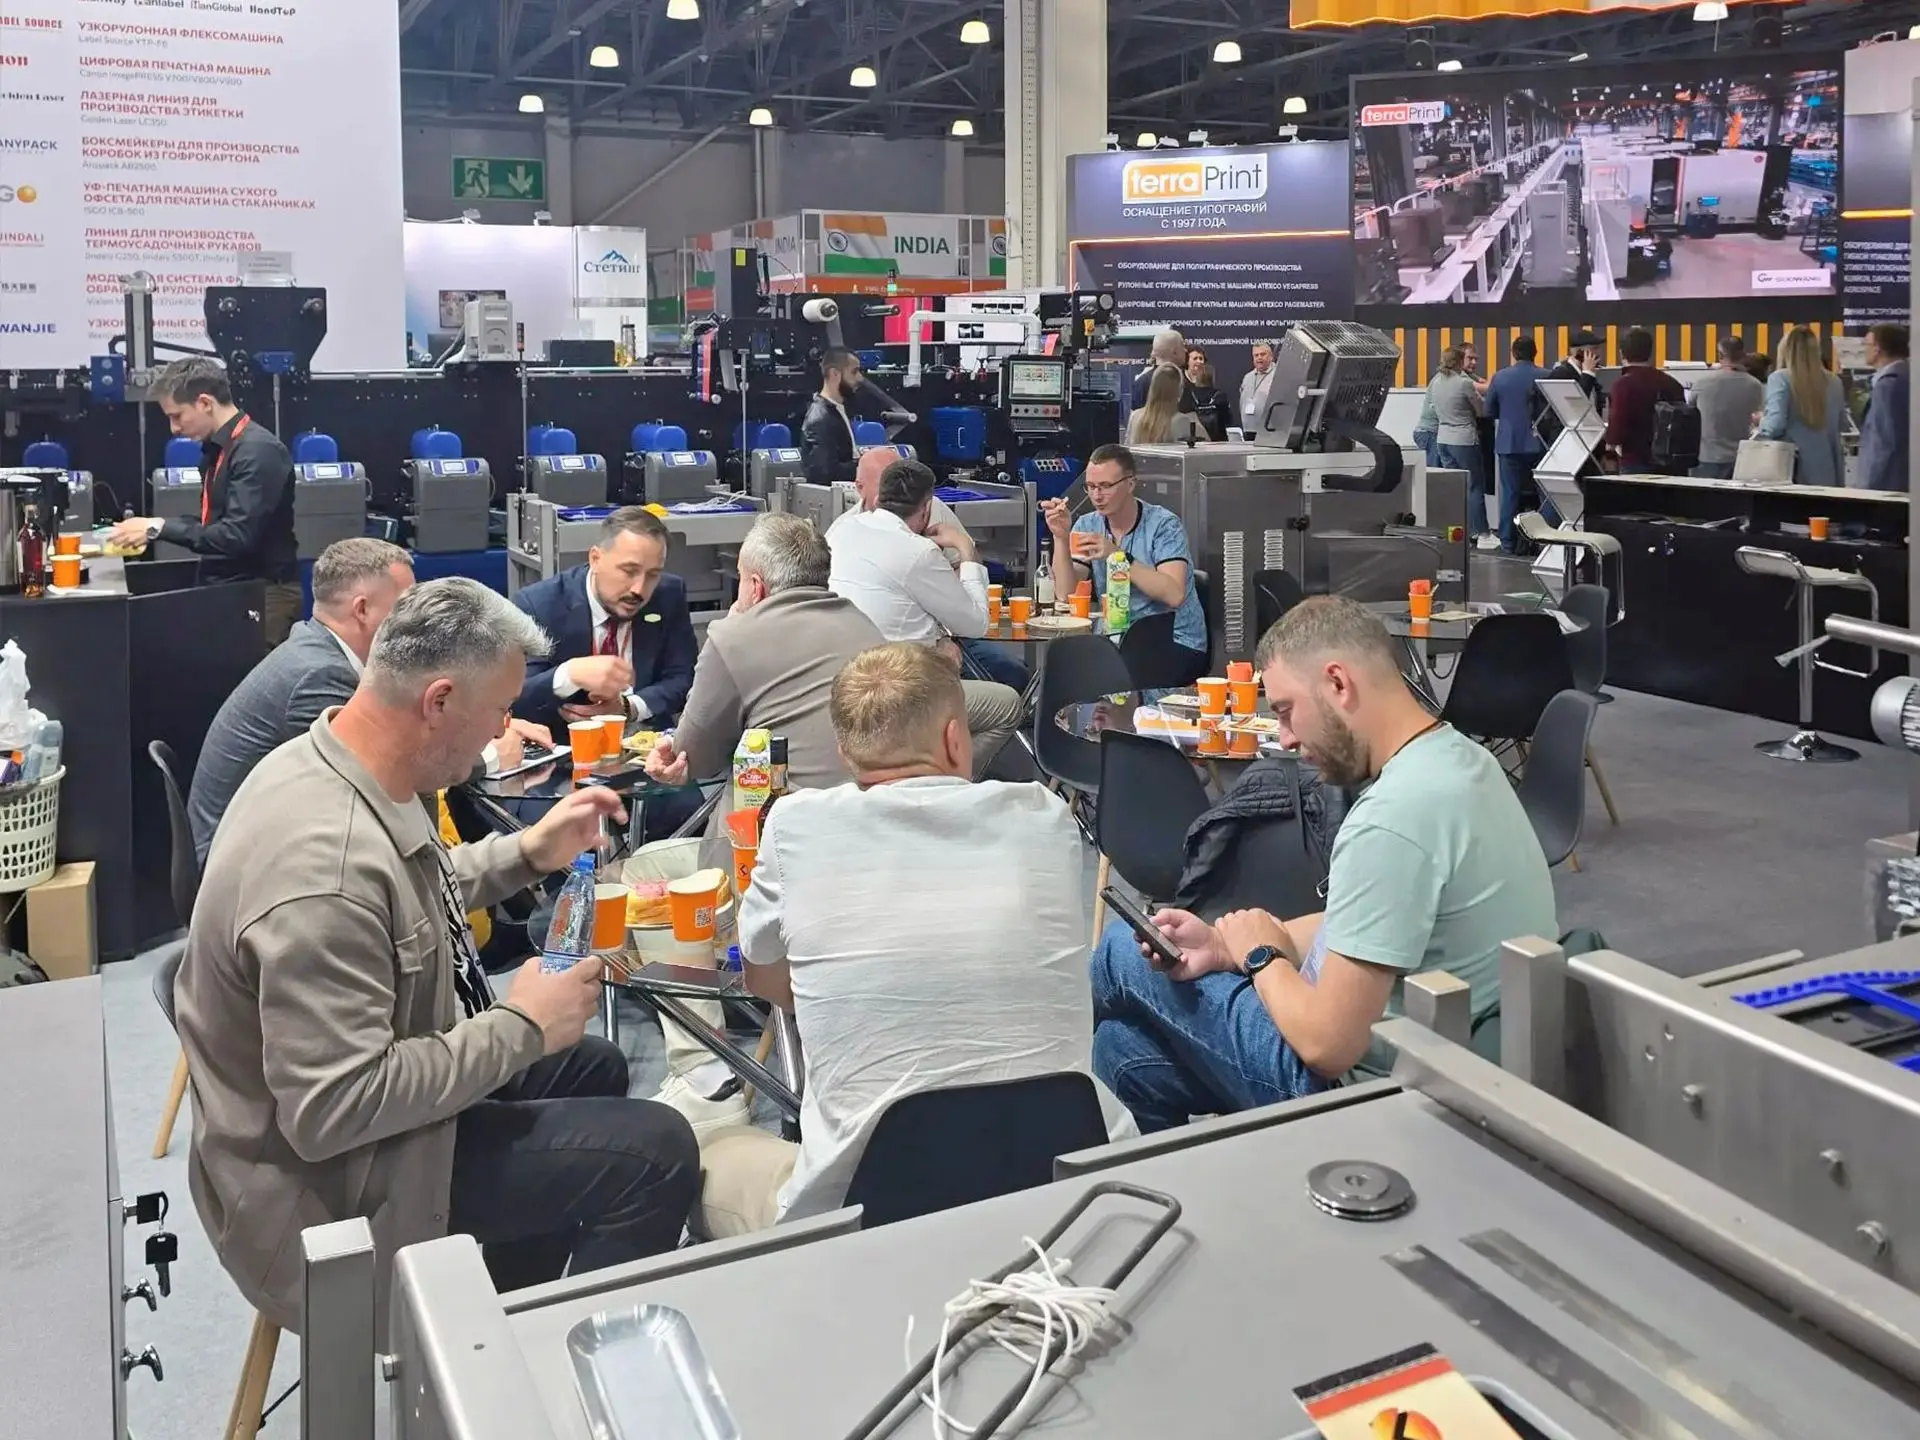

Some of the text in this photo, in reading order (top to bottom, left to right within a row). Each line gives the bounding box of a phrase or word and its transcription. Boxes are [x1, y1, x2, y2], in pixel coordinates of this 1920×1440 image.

[25, 18, 62, 29] SOURCE
[78, 22, 284, 44] УЗКОРУЛОННАЯ ФЛЕКСОМАШИНА
[79, 56, 271, 76] ЦИФРОВАЯ ПЕЧАТНАЯ МАШИНА
[80, 90, 217, 107] ЛАЗЕРНАЯ ЛИНИЯ ДЛЯ
[81, 102, 244, 119] ПРОИЗВОДСТВА ЭТИКЕТКИ
[82, 135, 300, 154] БОКСМЕЙКЕРЫ ДЛЯ ПРОИЗВОДСТВА
[82, 149, 260, 163] КОРОБОК ИЗ ГОФРОКАРТОНА
[84, 182, 277, 198] УФ-ПЕЧАТНАЯ МАШИНА СУХОГО
[84, 193, 316, 209] ОФСЕТА ДЛЯ ПЕЧАТИ НА СТАКАНЧИКАХ
[1123, 201, 1267, 218] ОСНАЩЕНИЕ ТИПОГРАФИЙ
[1161, 217, 1227, 229] С 1997 ГОДА
[85, 227, 255, 241] ЛИНИЯ ДЛЯ ПРОИЗВОДСТВА
[86, 239, 262, 252] ТЕРМОУСАДОЧНЫХ РУКАВОВ
[894, 235, 950, 254] INDIA
[1117, 262, 1170, 270] ОБОРУДОВАНИЕ
[1171, 262, 1185, 271] ДЛЯ
[1253, 264, 1302, 272] ПРОИЗВОДСТВА
[166, 275, 223, 284] СИСТЕМА
